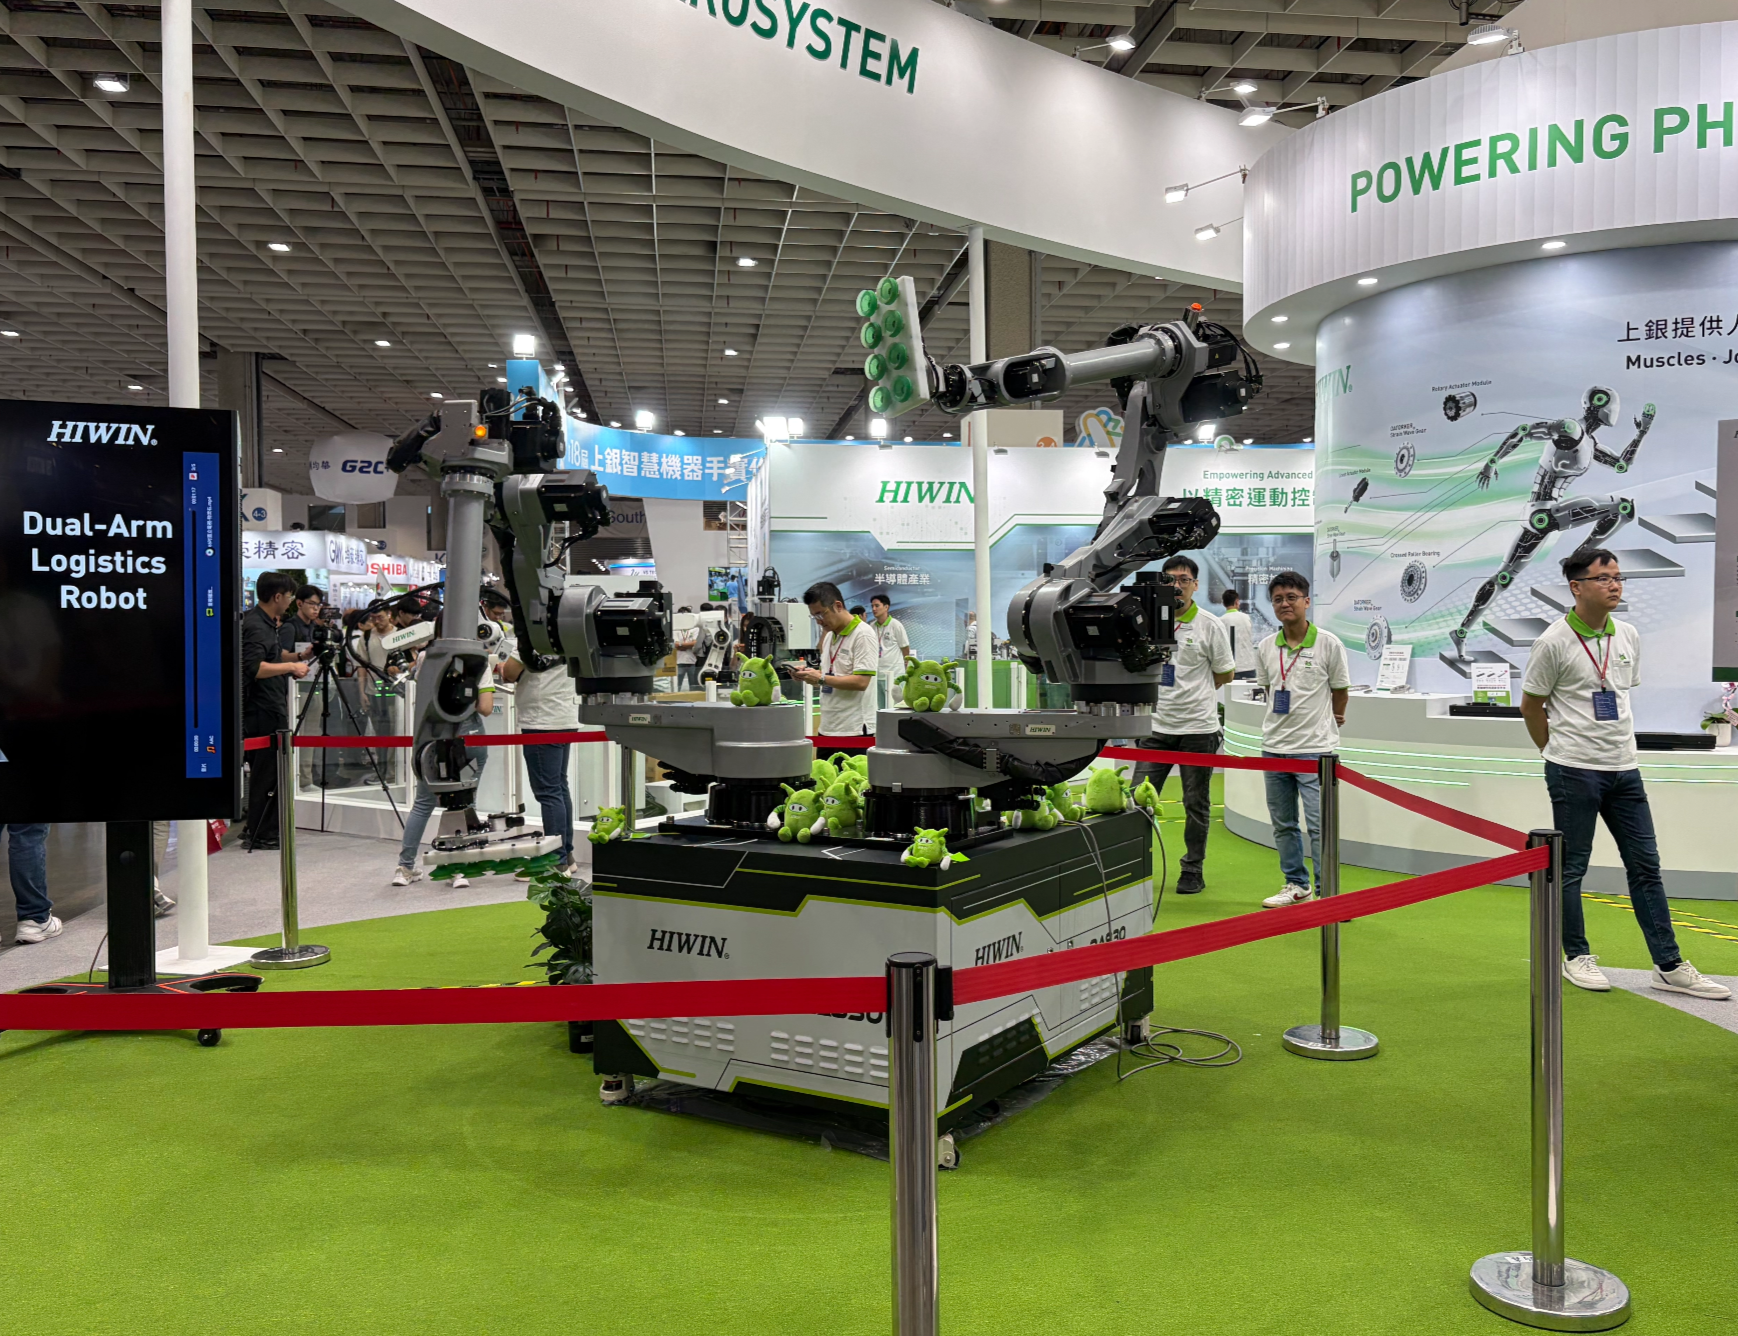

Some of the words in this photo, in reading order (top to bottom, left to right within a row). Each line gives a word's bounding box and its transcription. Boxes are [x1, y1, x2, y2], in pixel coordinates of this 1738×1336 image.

[688, 0, 919, 94] OSYSTEM
[1351, 114, 1629, 213] POWERING
[1653, 101, 1734, 153] PH
[1626, 351, 1706, 370] Muscles
[1472, 379, 1492, 387] Module
[1203, 470, 1265, 482] Empowering
[1267, 470, 1314, 480] Advanced
[875, 480, 975, 504] HIWIN
[1182, 487, 1316, 508] 以精密運動控
[23, 510, 173, 539] Dual-Arm
[31, 547, 167, 578] Logistics
[1422, 549, 1441, 558] Bearing
[366, 562, 408, 576] SHIBA
[874, 573, 931, 586] 半導體產業
[60, 585, 147, 610] Robot
[392, 630, 415, 644] HIWIN
[647, 928, 728, 959] HIWIN
